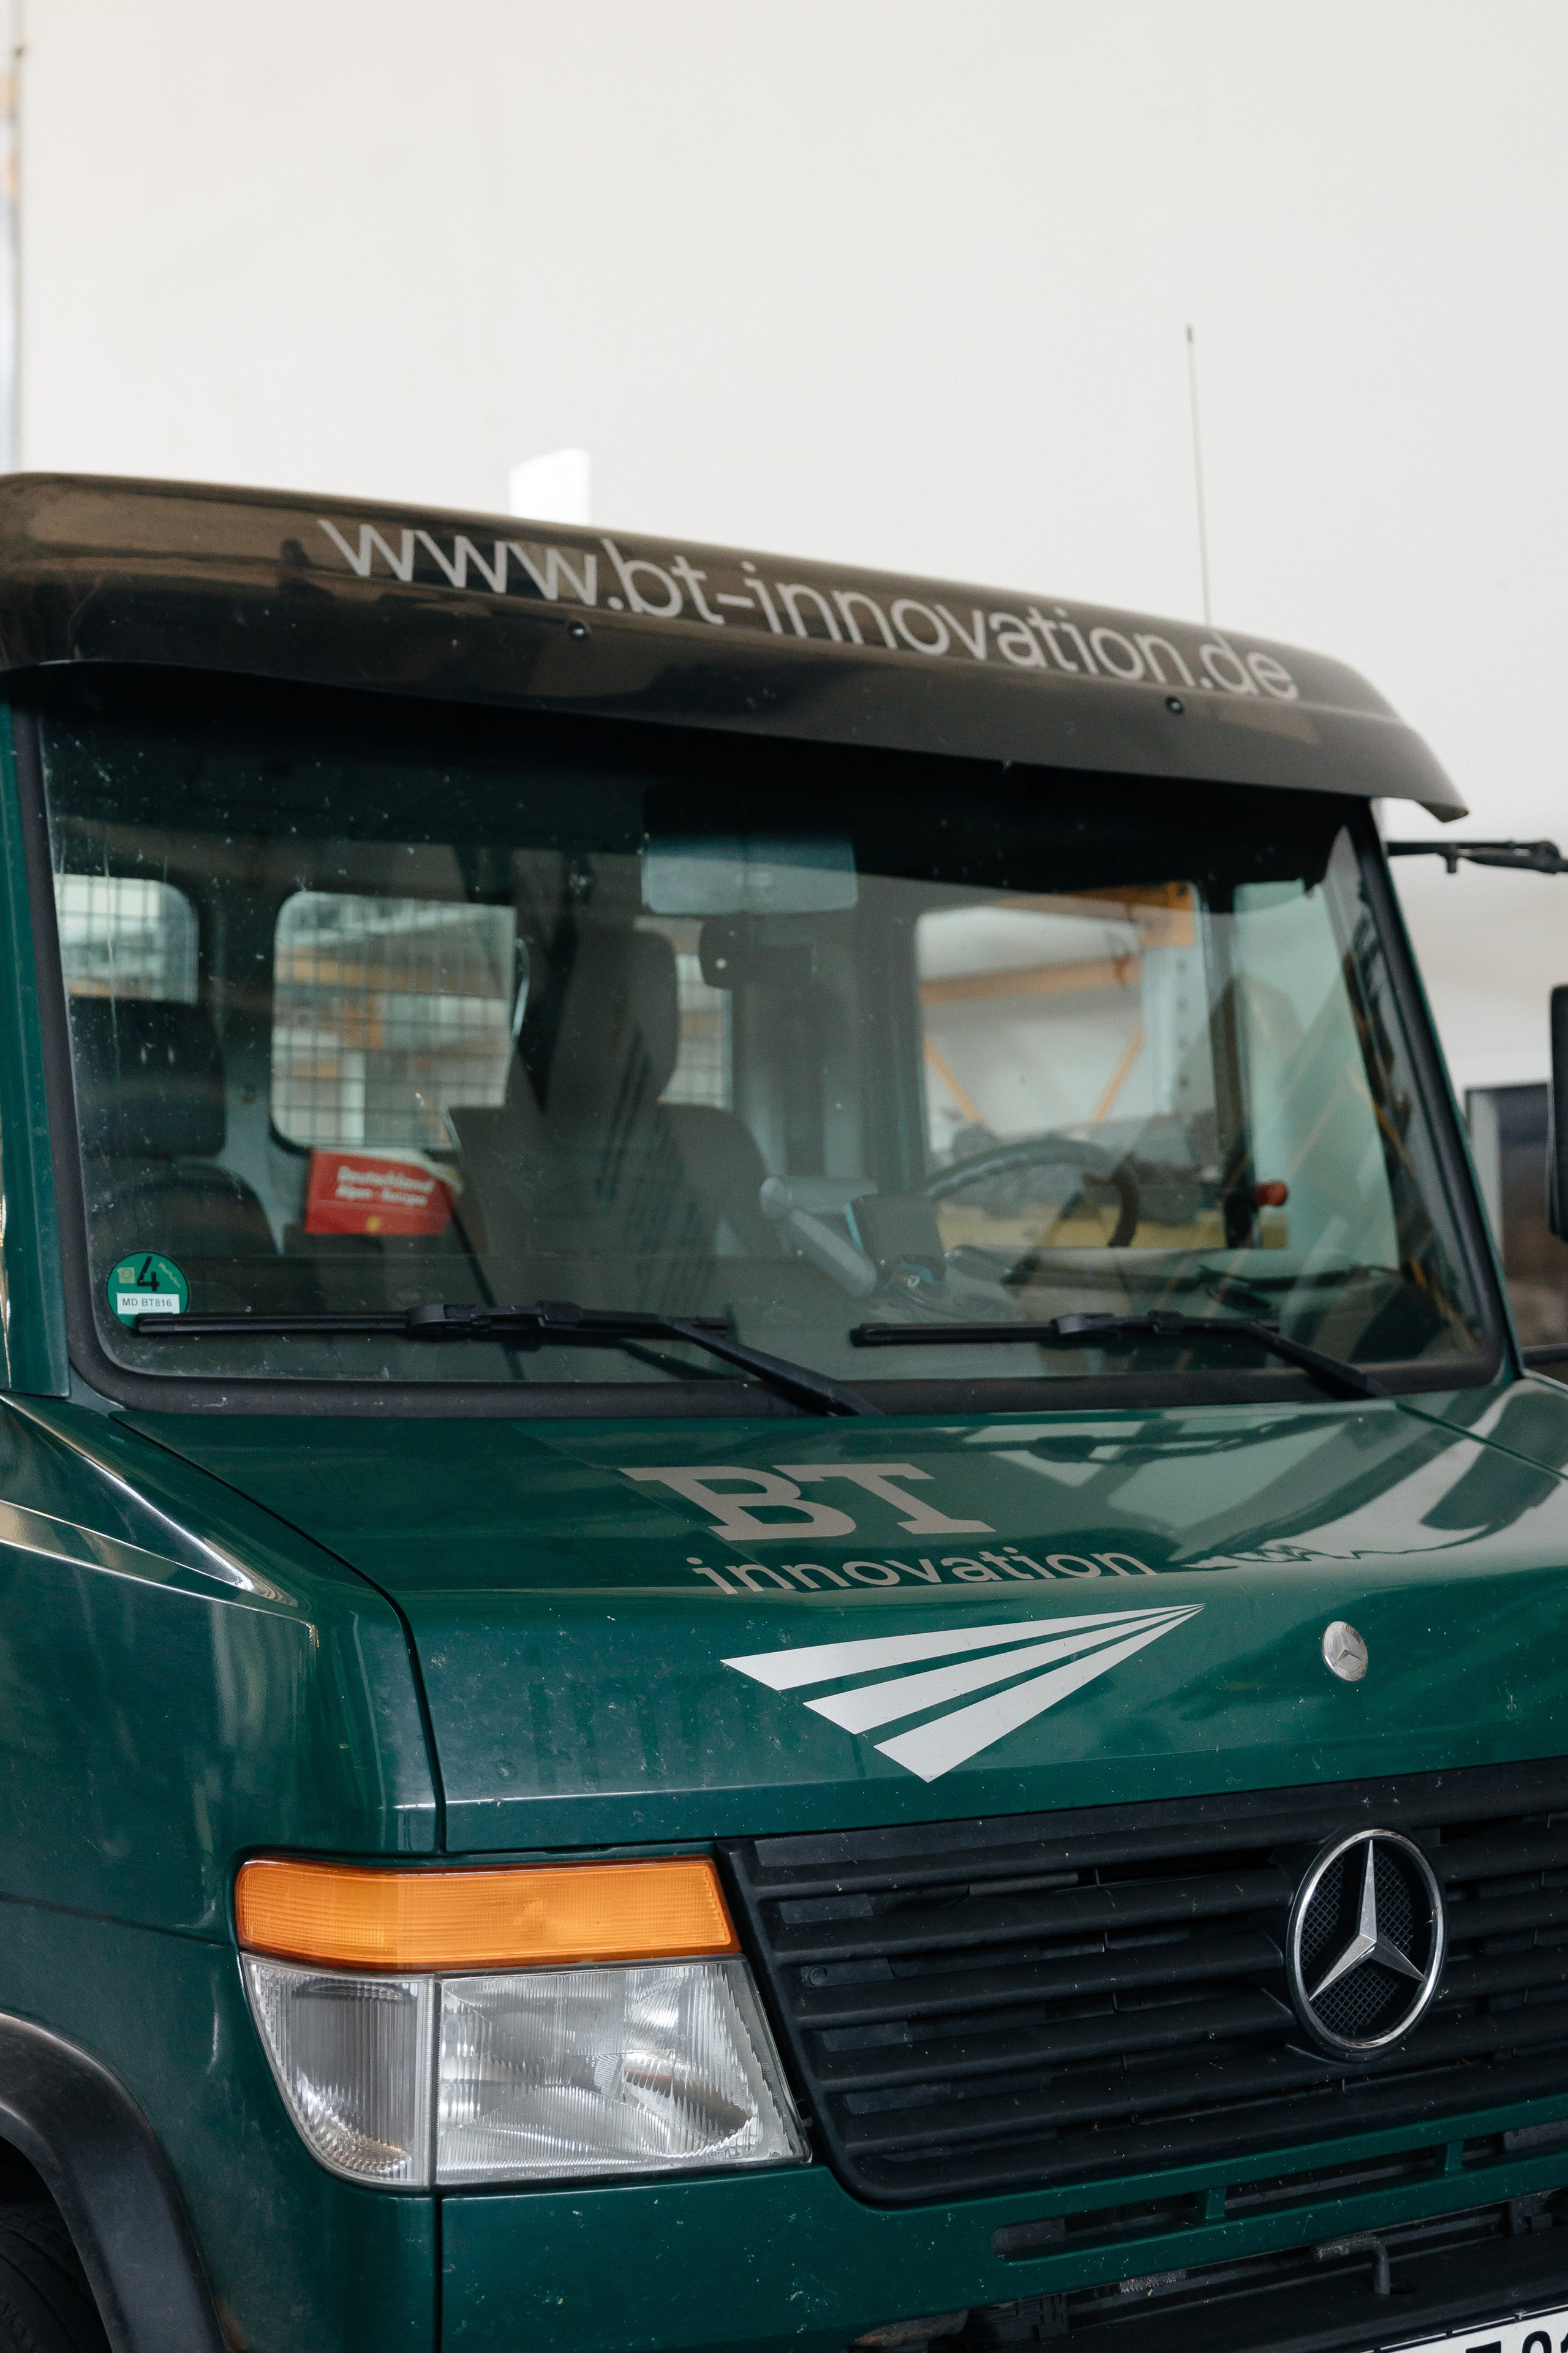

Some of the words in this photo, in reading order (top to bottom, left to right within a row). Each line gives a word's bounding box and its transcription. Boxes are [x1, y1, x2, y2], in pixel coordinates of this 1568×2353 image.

[316, 518, 1298, 701] www.bt-innovation.de
[137, 1256, 159, 1292] 4
[122, 1297, 138, 1306] MD
[141, 1298, 172, 1307] BT816
[620, 1463, 997, 1542] BT
[686, 1546, 1158, 1595] innovation
